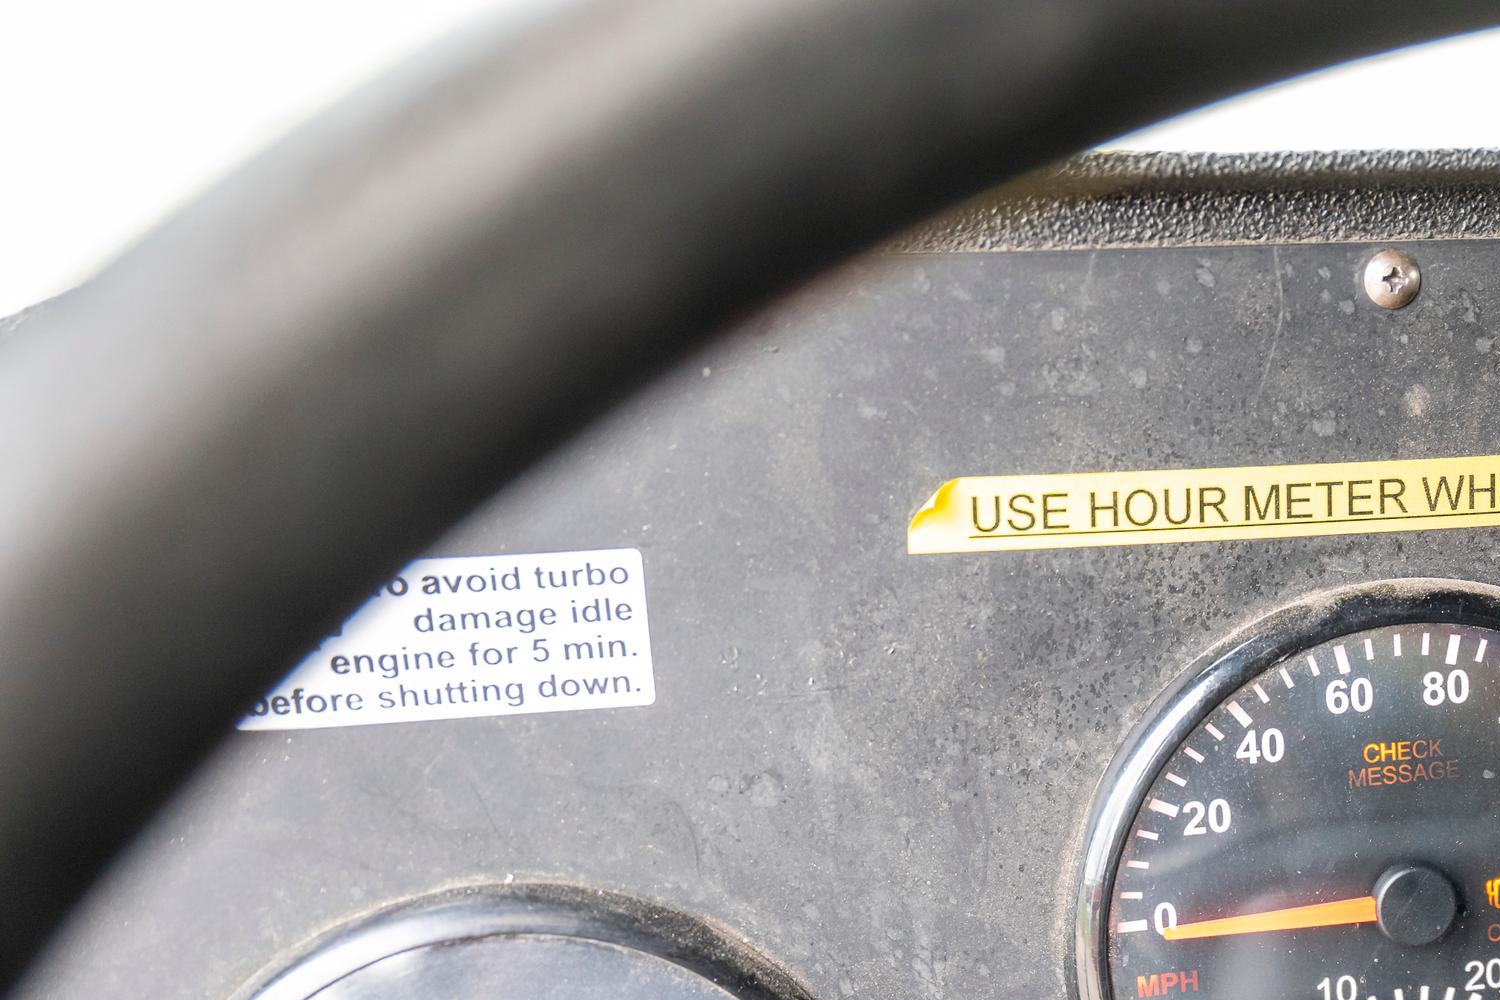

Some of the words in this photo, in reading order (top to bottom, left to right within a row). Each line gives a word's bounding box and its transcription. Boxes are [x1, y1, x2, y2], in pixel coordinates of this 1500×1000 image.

[970, 492, 1071, 533] USE
[1090, 486, 1229, 528] HOUR
[1244, 477, 1407, 521] METER
[378, 576, 409, 597] o
[421, 566, 521, 596] avoid
[535, 562, 630, 589] turbo
[413, 606, 557, 634] damage
[571, 598, 633, 624] idle
[330, 646, 455, 679] engine
[469, 642, 519, 666] for
[532, 639, 550, 663] 5
[564, 634, 638, 661] min.
[378, 680, 525, 708] shutting
[538, 673, 642, 698] down.
[1325, 677, 1374, 715] 60
[1422, 669, 1470, 706] 80
[1235, 728, 1286, 765] 40
[1363, 739, 1443, 763] CHECK
[1348, 760, 1460, 788] MESSAGE
[1182, 798, 1232, 837] 20
[1153, 902, 1178, 936] 0
[1136, 970, 1200, 999] MPH
